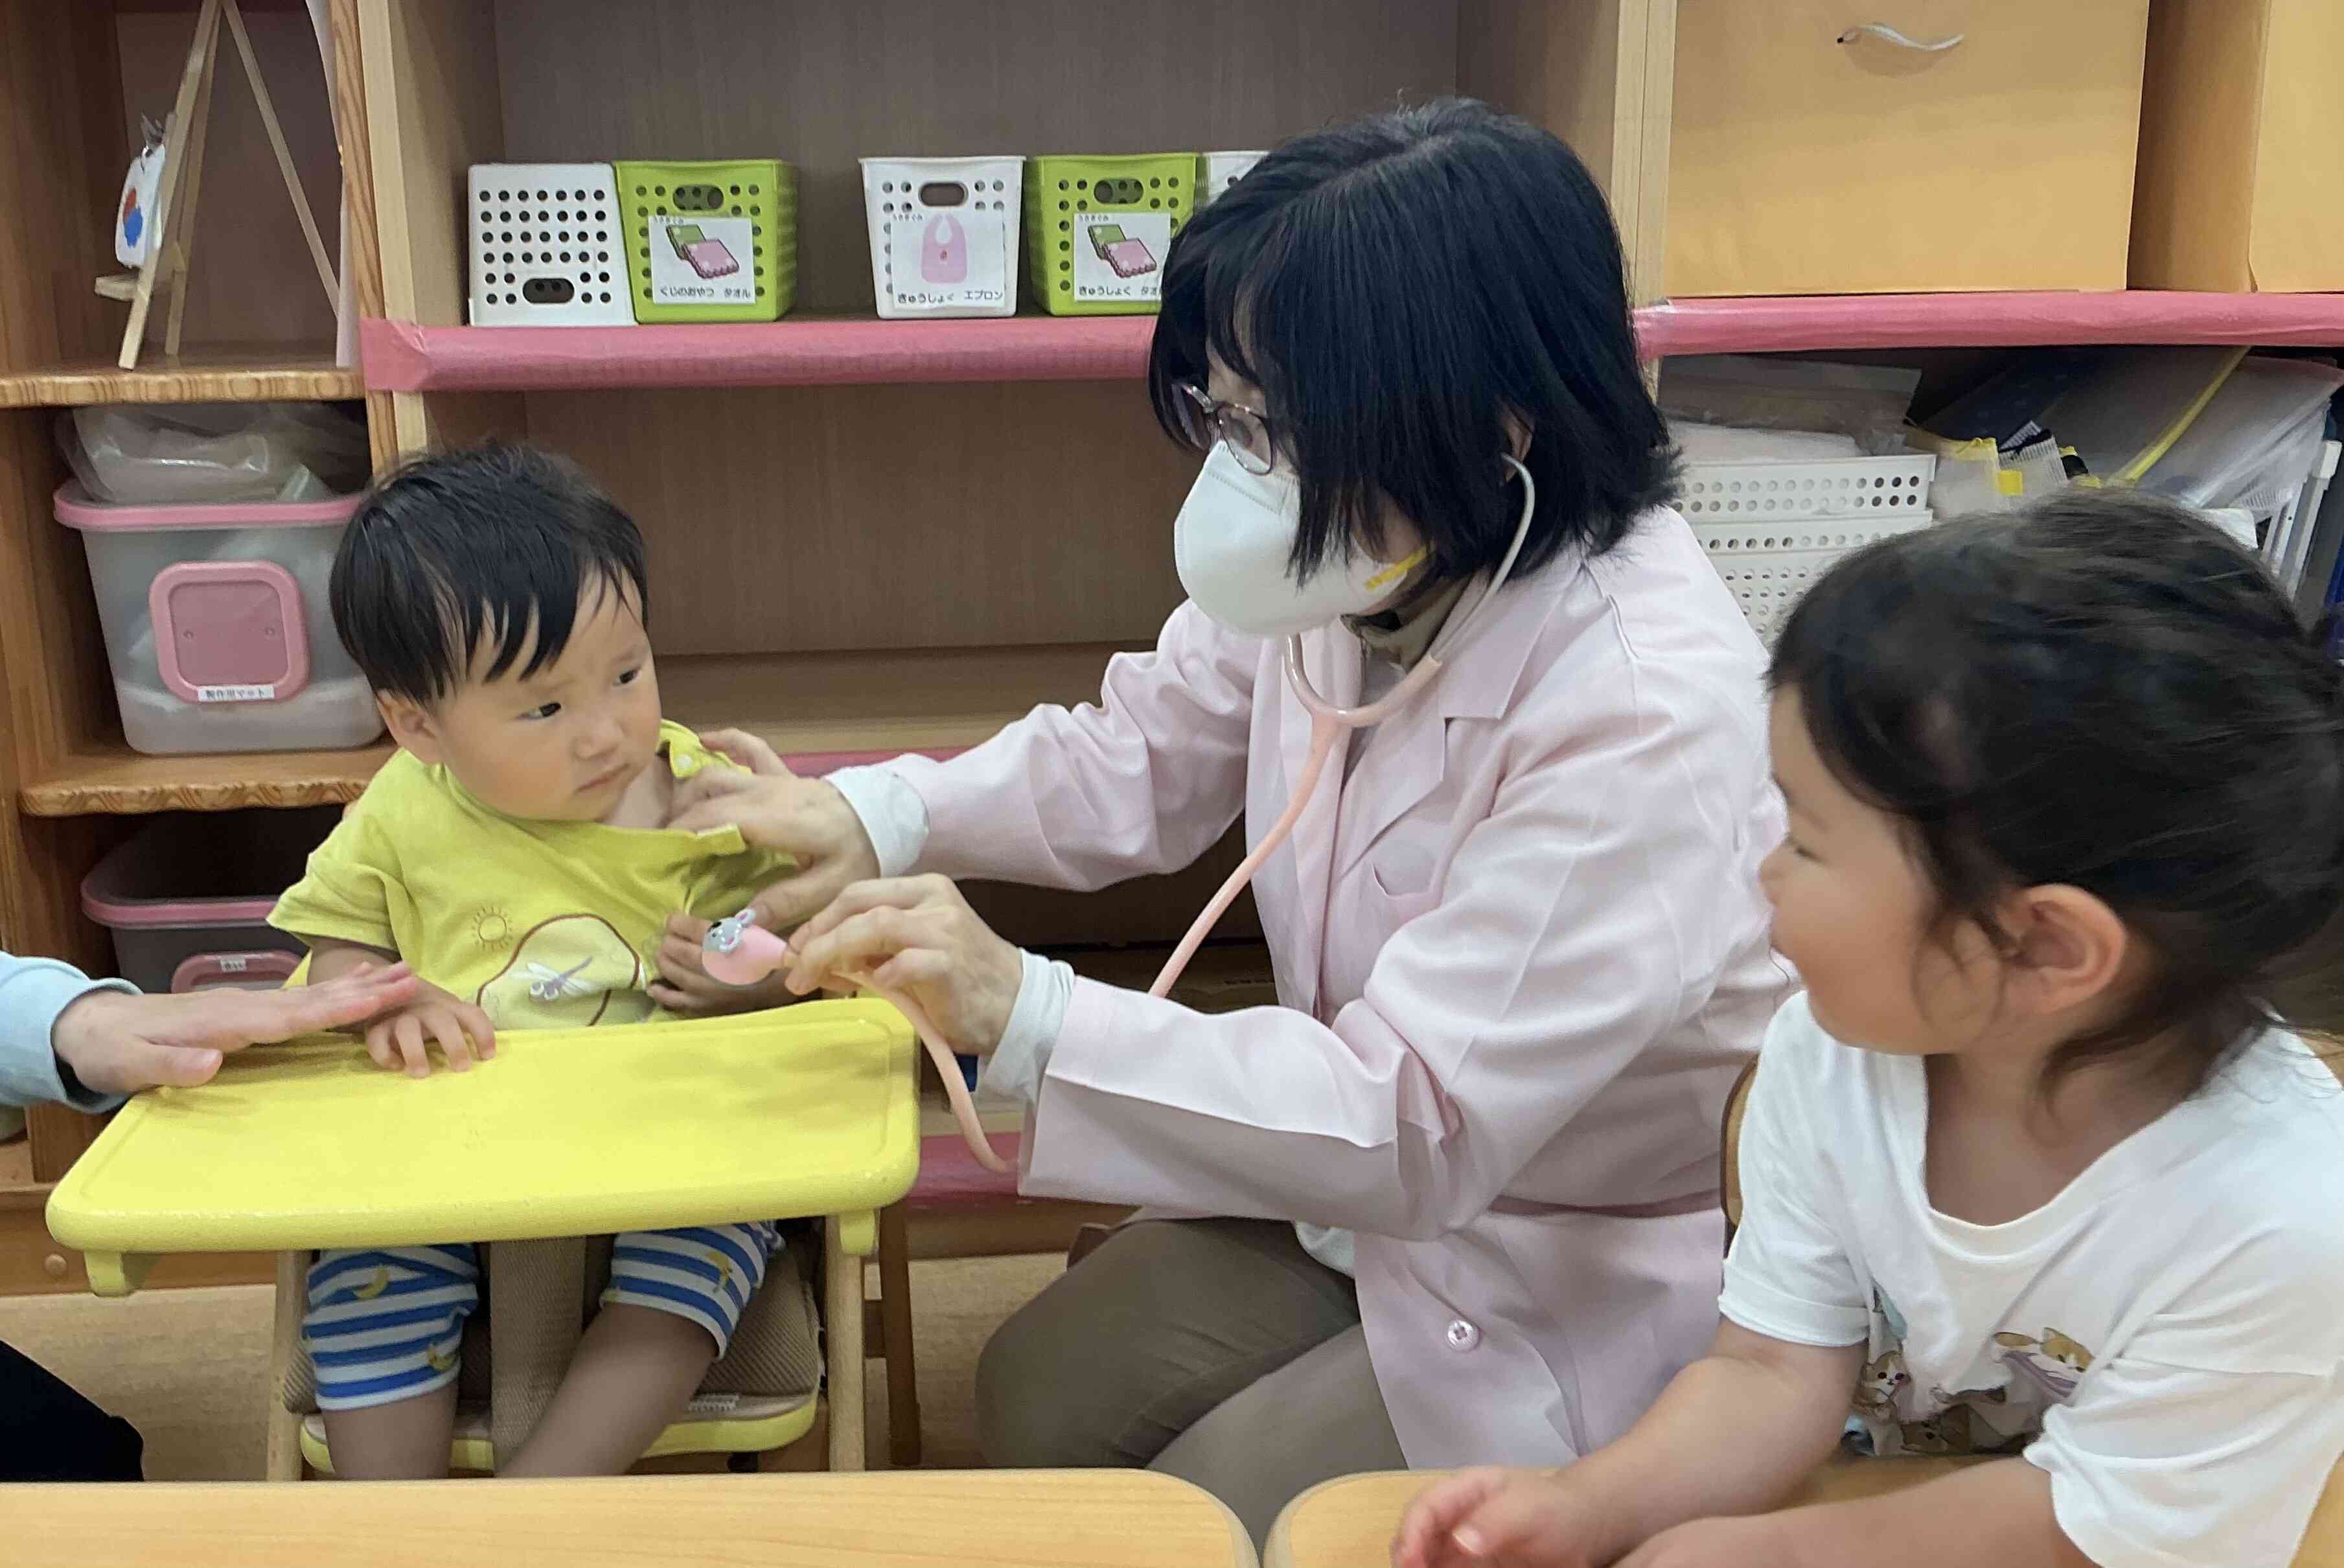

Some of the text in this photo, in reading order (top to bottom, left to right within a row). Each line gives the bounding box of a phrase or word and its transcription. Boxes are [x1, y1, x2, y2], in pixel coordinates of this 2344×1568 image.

[1079, 285, 1162, 295] きゅうしょく タオ
[898, 290, 1003, 303] きゅうしょく エプロン
